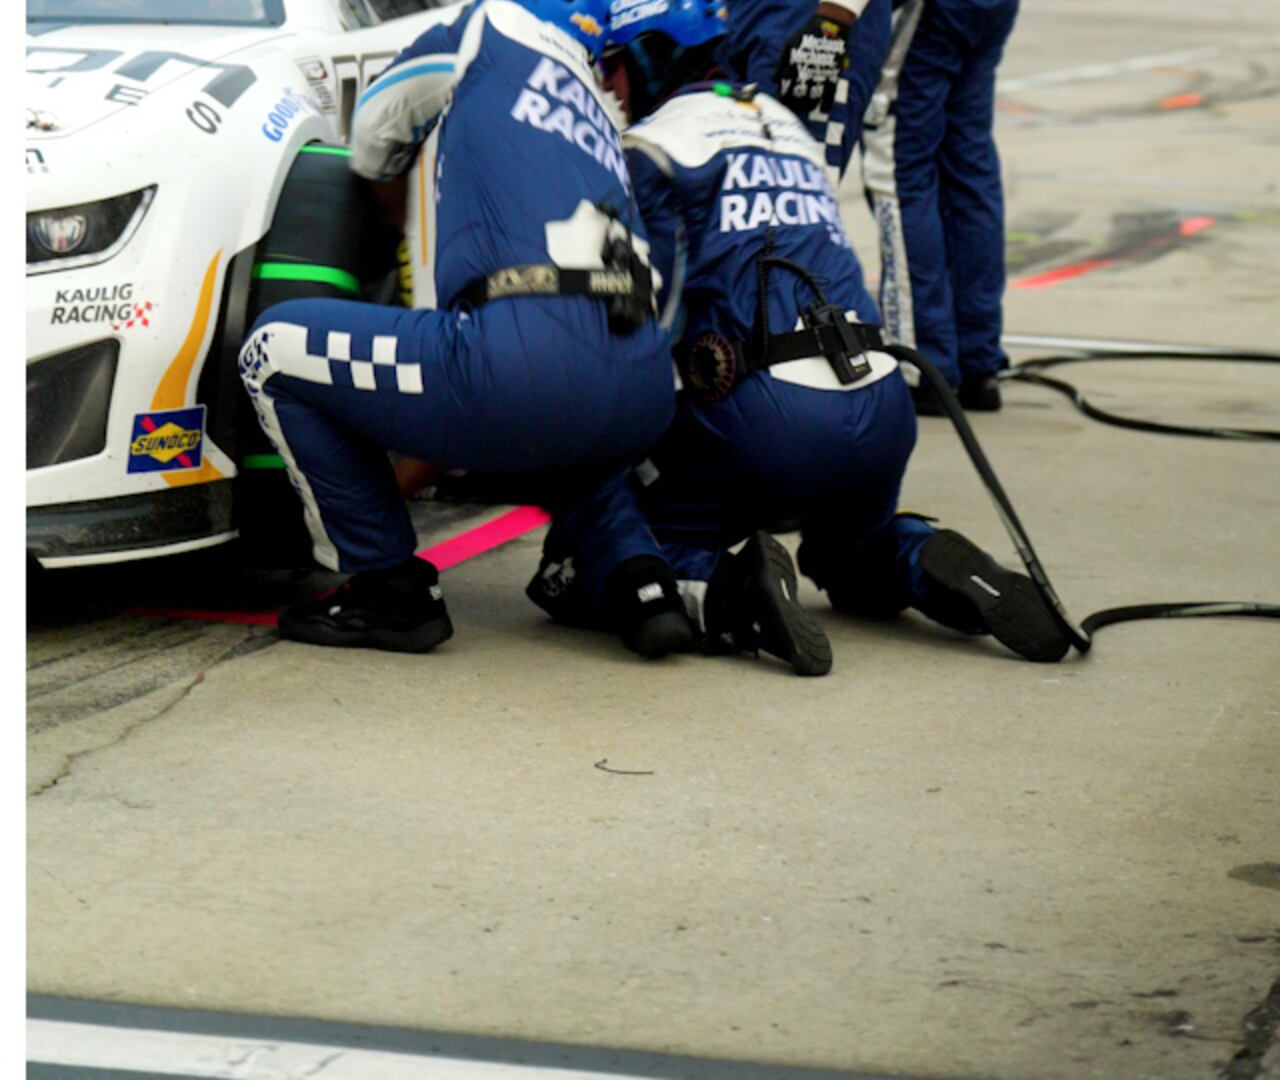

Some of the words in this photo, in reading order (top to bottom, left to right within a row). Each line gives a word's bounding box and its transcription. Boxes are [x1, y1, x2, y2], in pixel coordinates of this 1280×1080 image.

[511, 88, 630, 197] RACIN
[55, 283, 132, 304] KAULIG
[50, 303, 132, 325] RACING
[134, 432, 200, 452] SUNOCO
